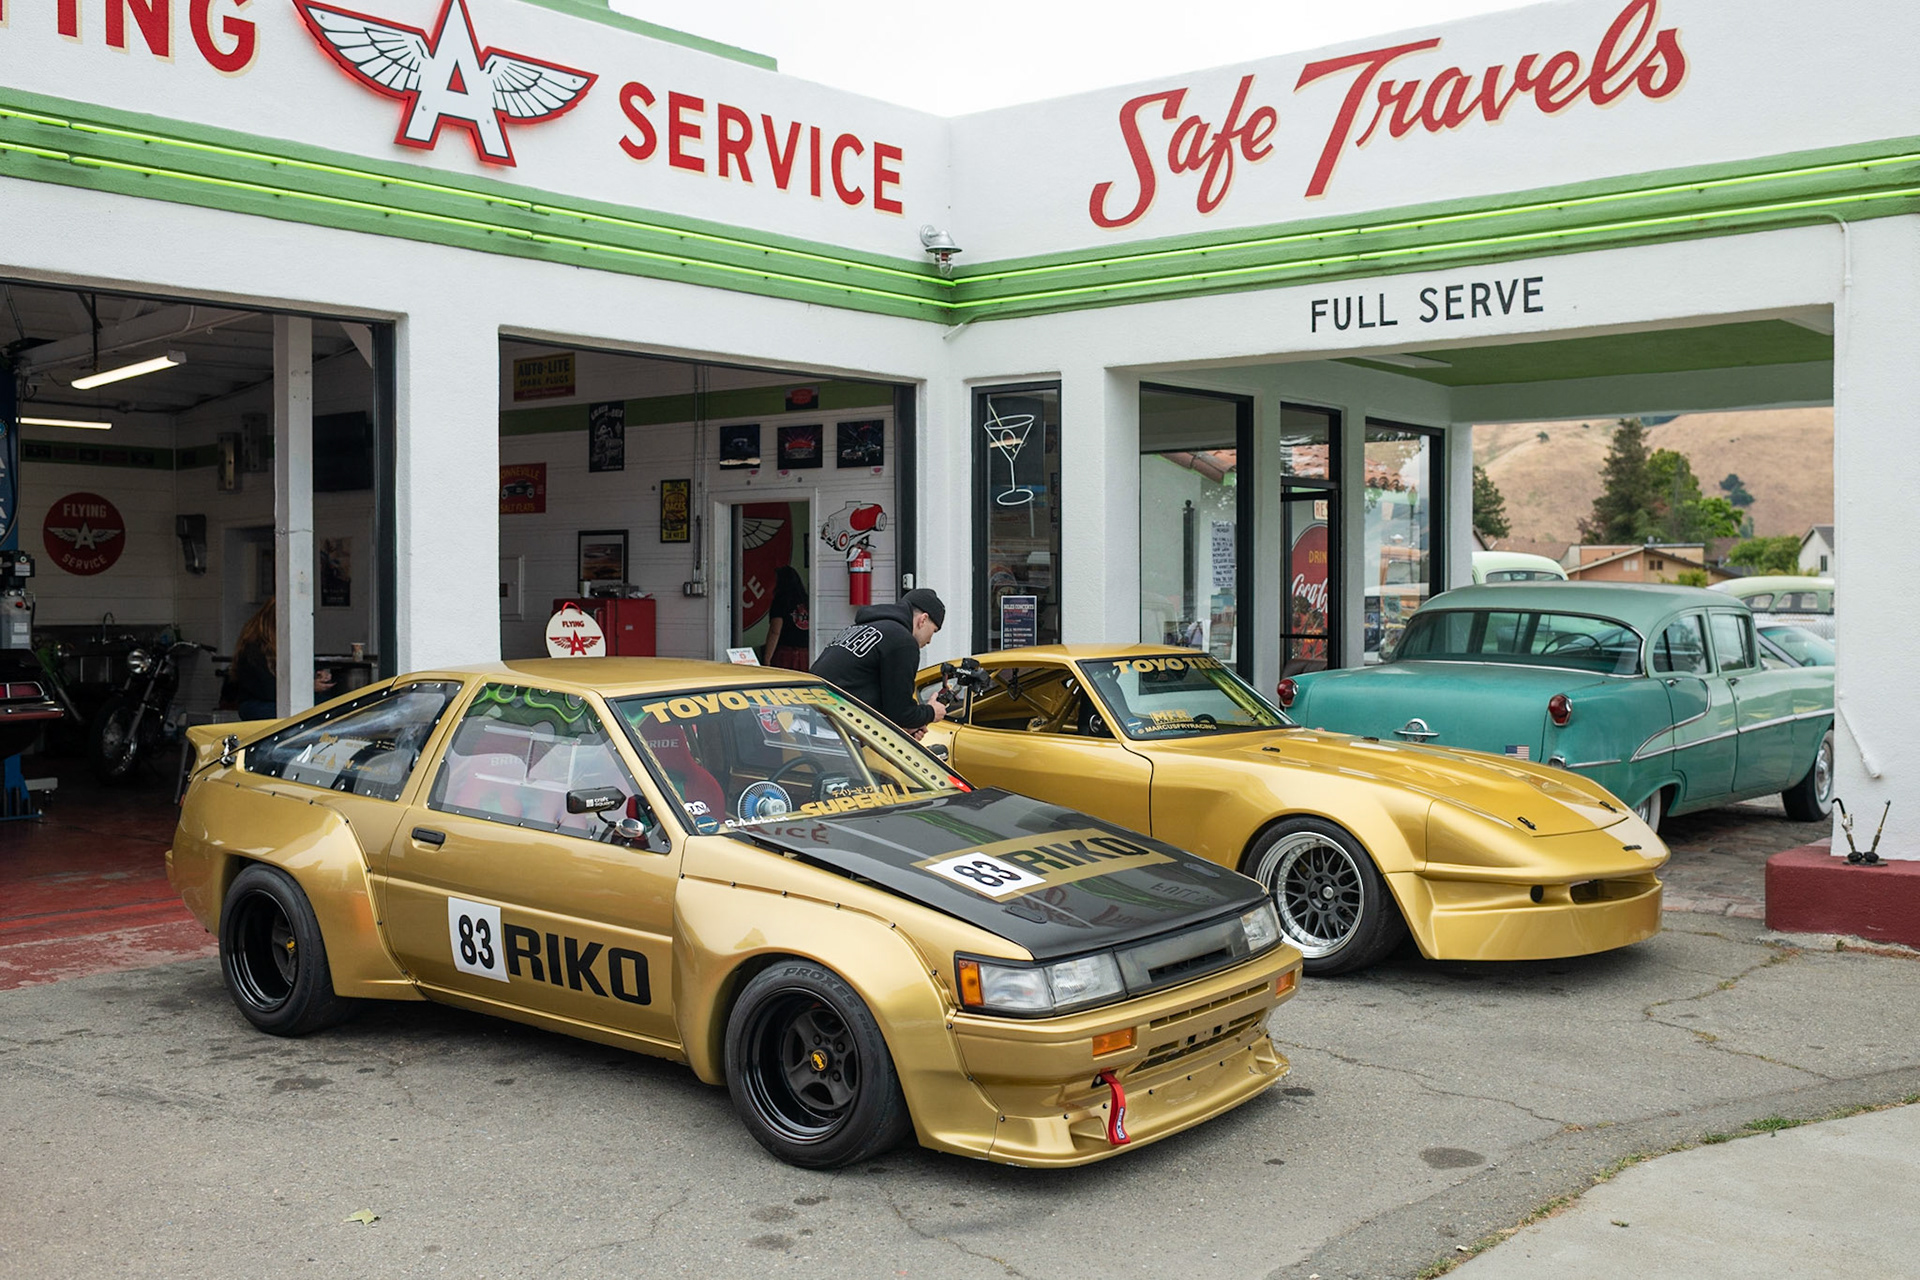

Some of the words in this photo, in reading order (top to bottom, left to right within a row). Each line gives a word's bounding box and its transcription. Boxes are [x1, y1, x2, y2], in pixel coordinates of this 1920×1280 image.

[1089, 74, 1278, 229] Safe
[1294, 0, 1687, 198] Travels
[618, 81, 904, 215] SERVICE
[1311, 293, 1398, 333] FULL
[1419, 276, 1545, 323] SERVE
[518, 358, 570, 376] AUTO-LITE
[501, 467, 541, 480] ONNEVILLE
[63, 503, 108, 518] FLYING
[62, 553, 108, 570] SERVICE
[1309, 551, 1328, 564] DRIN
[1112, 657, 1185, 675] TOYO
[1181, 656, 1225, 670] TIRE
[641, 691, 750, 724] TOYO
[743, 687, 841, 707] TIRES
[645, 738, 680, 751] RIDE
[953, 860, 1023, 888] 83
[994, 837, 1150, 876] RIKO
[457, 914, 495, 970] 83
[503, 923, 652, 1006] RIKO
[783, 966, 859, 1009] PROXES
